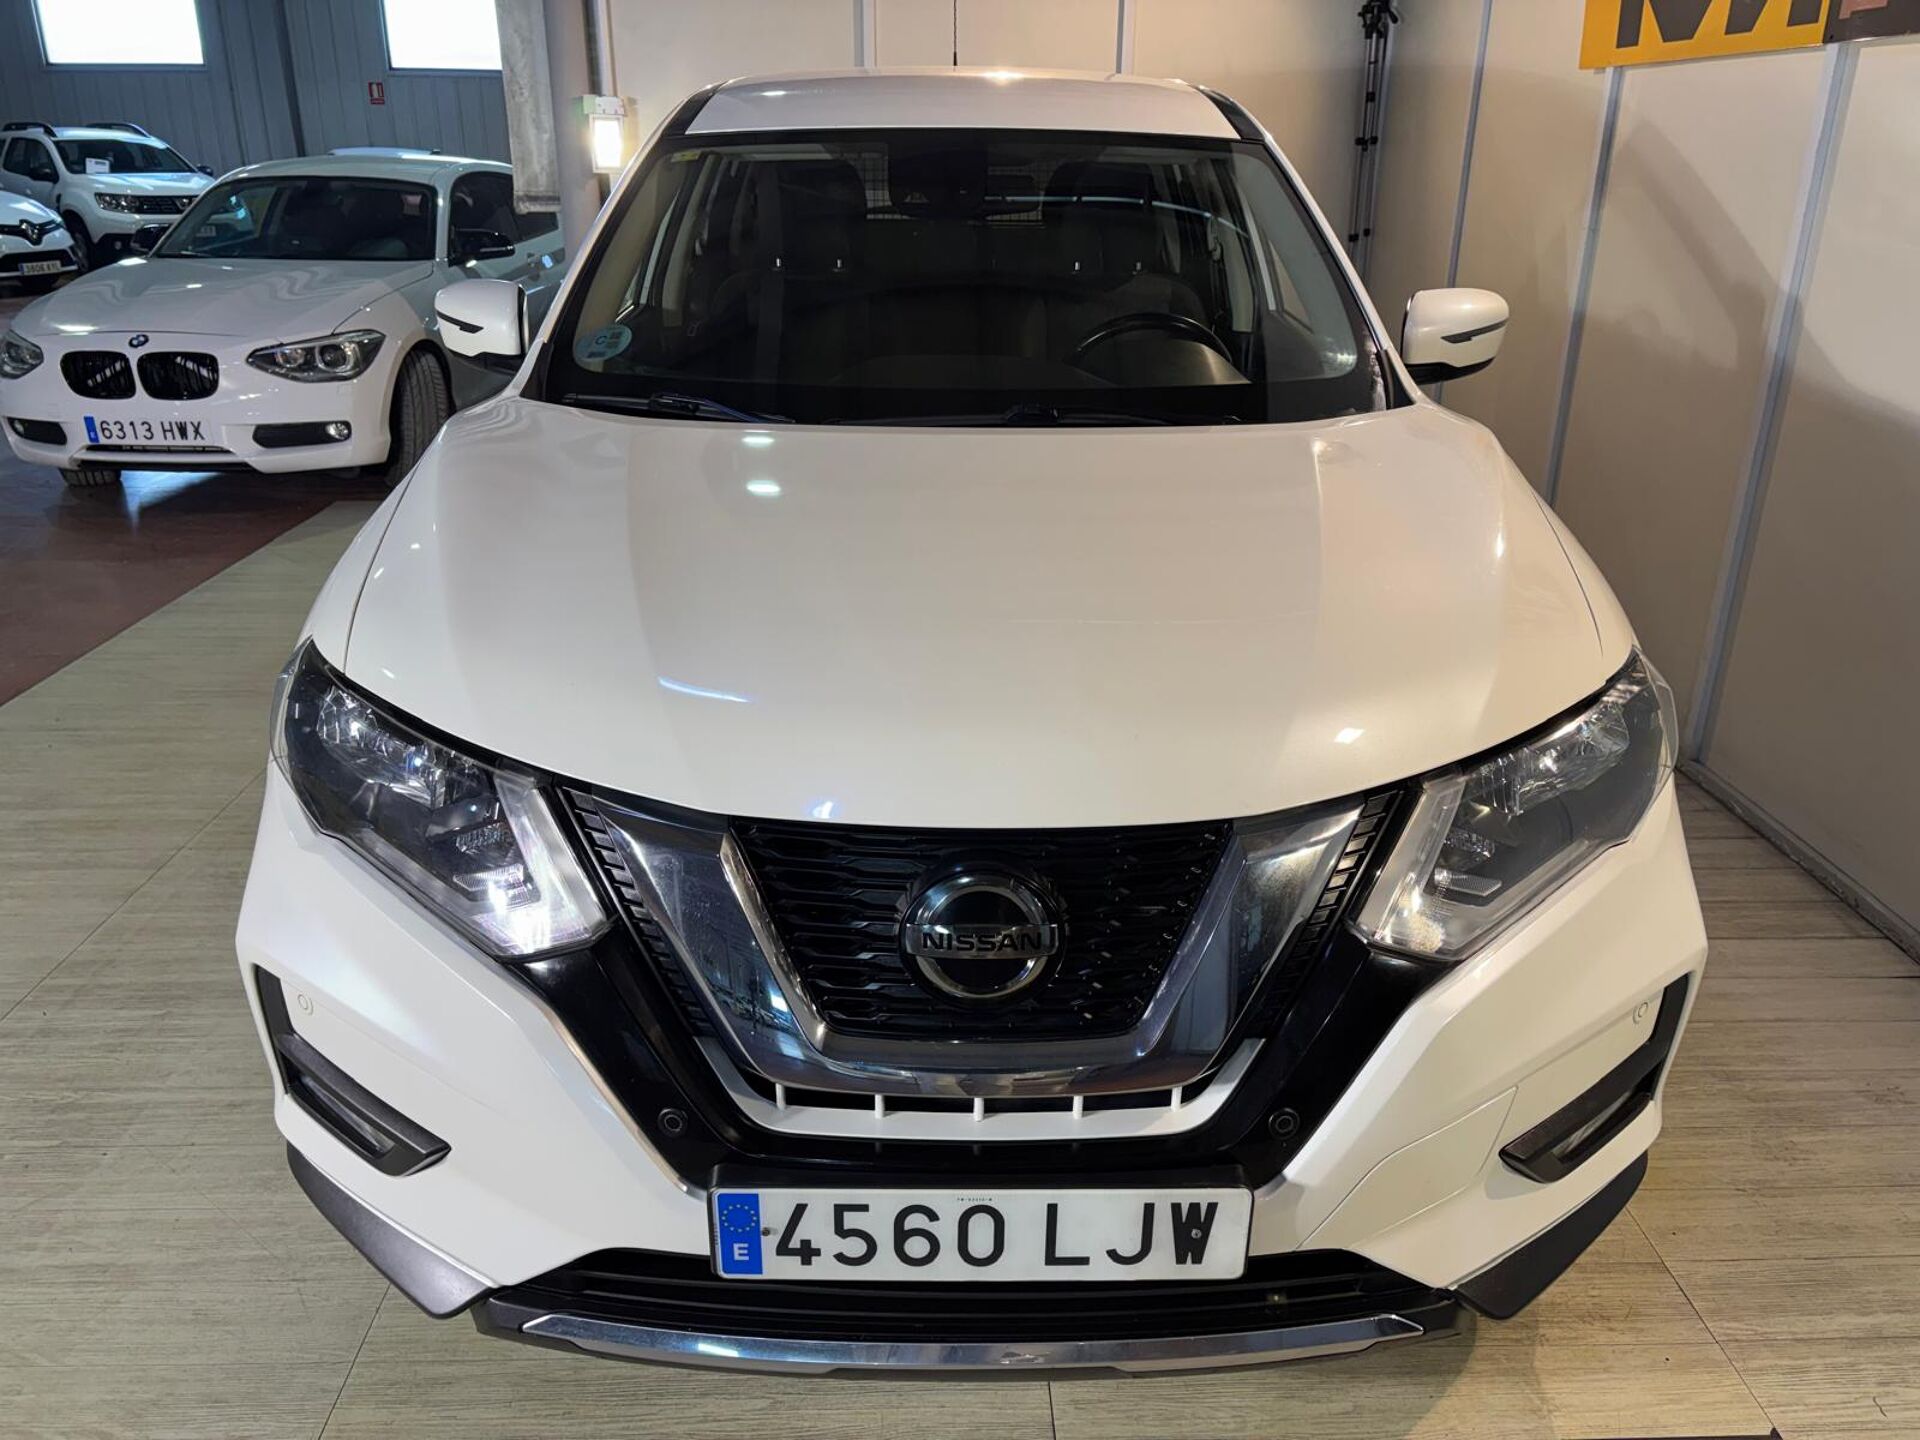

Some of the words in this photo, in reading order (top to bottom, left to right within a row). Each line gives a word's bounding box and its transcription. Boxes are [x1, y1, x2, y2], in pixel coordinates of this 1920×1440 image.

[99, 420, 155, 441] 6313
[160, 420, 206, 441] HWX
[922, 932, 1042, 952] NISSAN
[732, 1242, 750, 1261] E
[775, 1202, 1006, 1268] 4560
[1044, 1201, 1219, 1267] LJW
